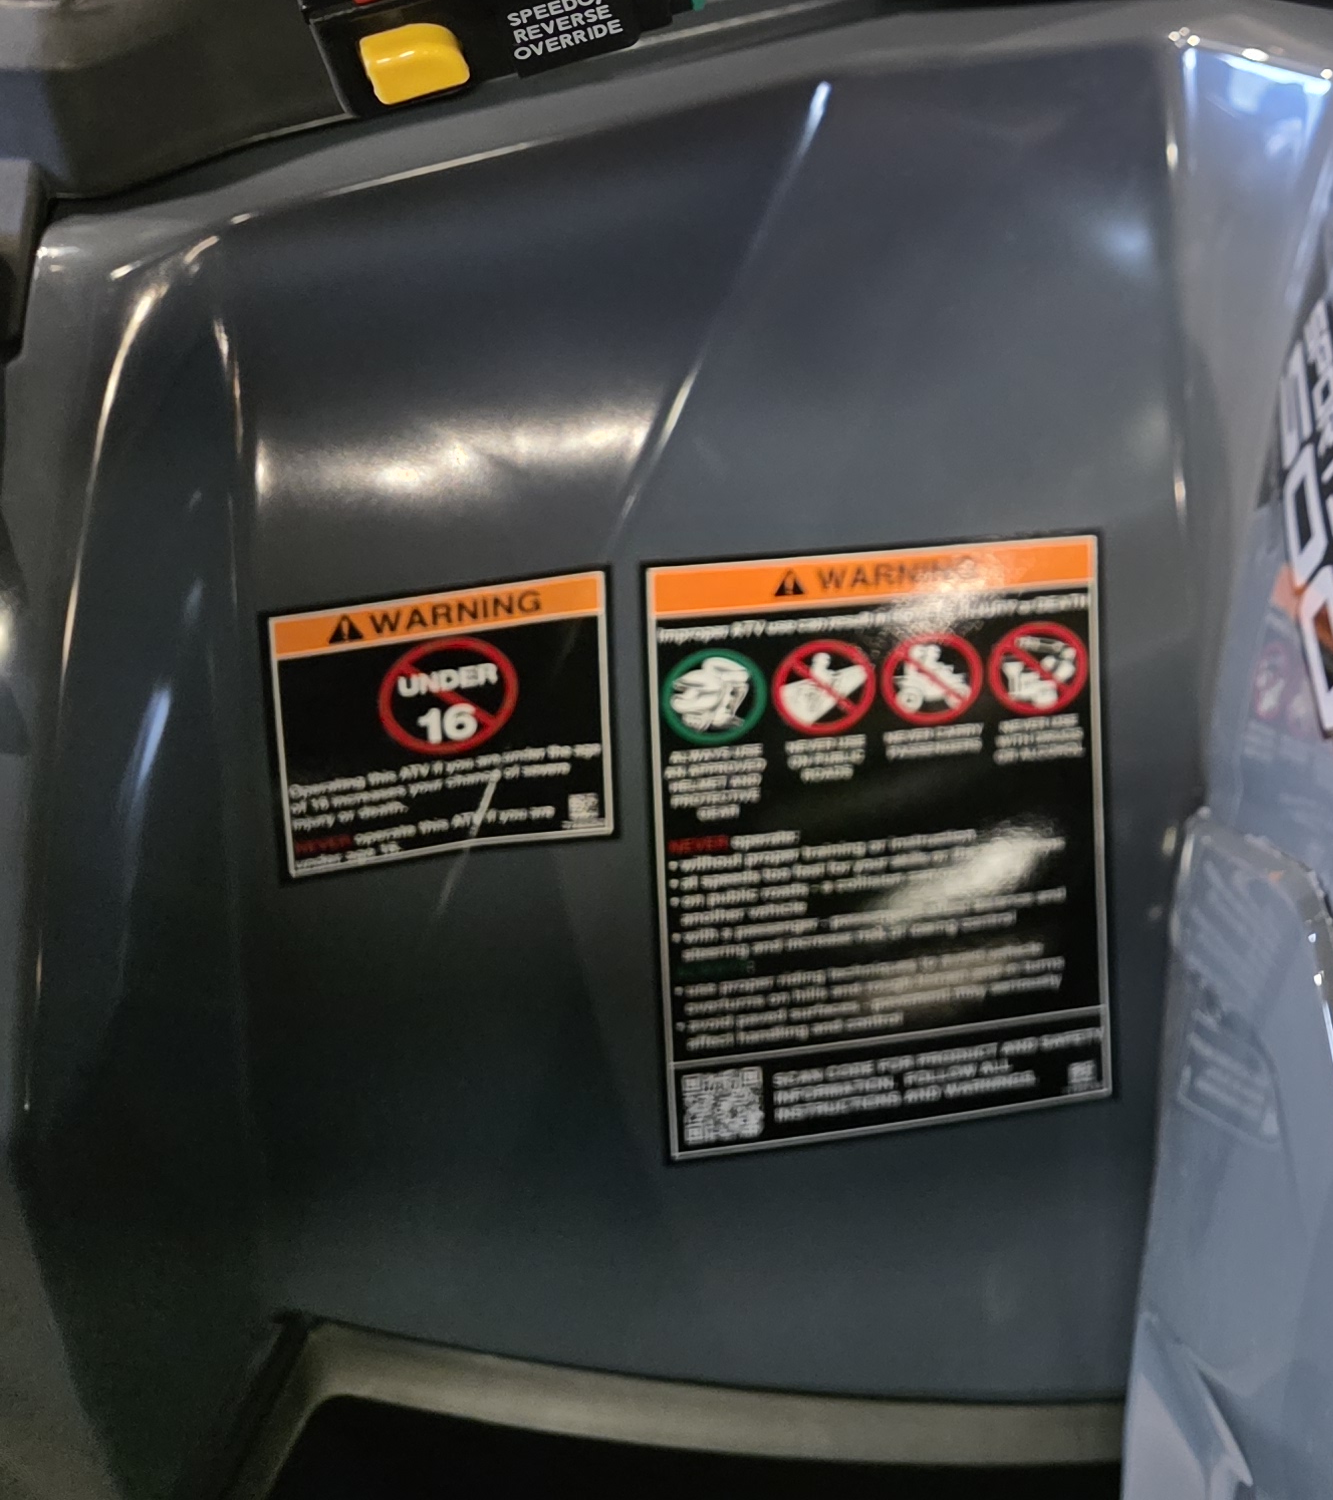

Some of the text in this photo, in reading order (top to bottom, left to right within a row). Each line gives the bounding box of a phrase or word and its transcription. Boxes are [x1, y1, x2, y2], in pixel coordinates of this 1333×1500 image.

[513, 4, 613, 44] REVERSE
[513, 18, 623, 60] OVERRIDE
[369, 590, 542, 634] WARNING
[398, 663, 498, 697] UNDER
[418, 703, 477, 743] 16
